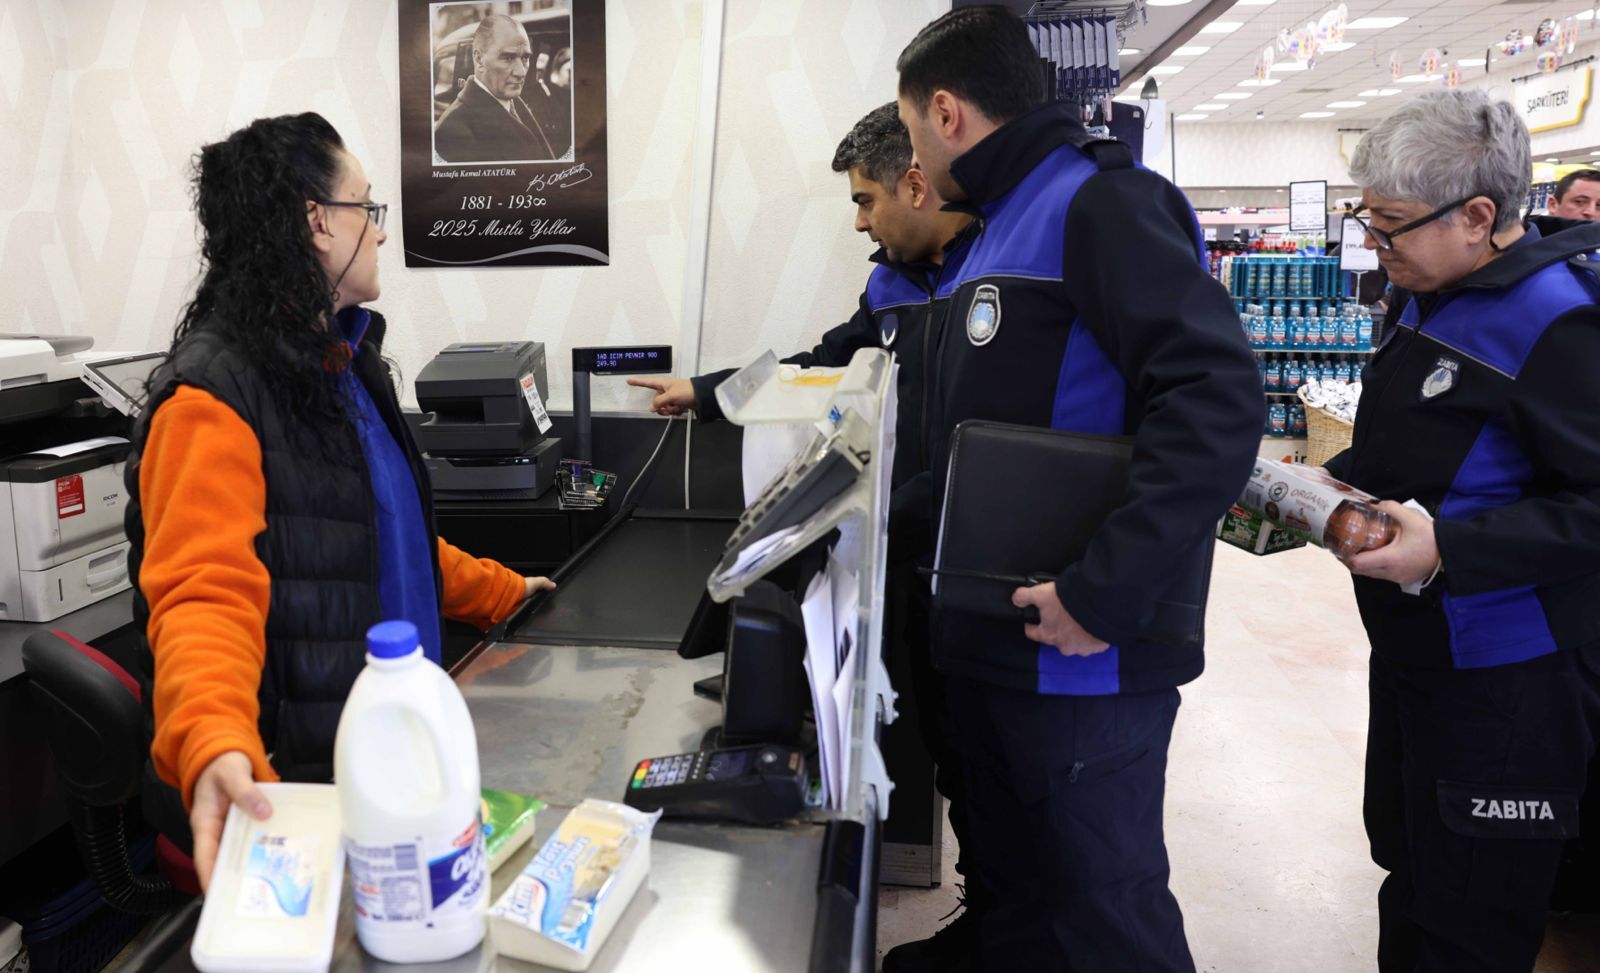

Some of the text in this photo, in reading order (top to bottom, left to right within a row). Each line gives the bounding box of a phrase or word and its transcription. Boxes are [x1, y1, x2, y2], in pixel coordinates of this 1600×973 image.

[432, 168, 517, 179] Mustafa Kemal ATATÜRK
[460, 195, 493, 210] 1881
[428, 218, 576, 240] 2025 Mutlu Yıllar
[1471, 798, 1555, 820] ZABITA
